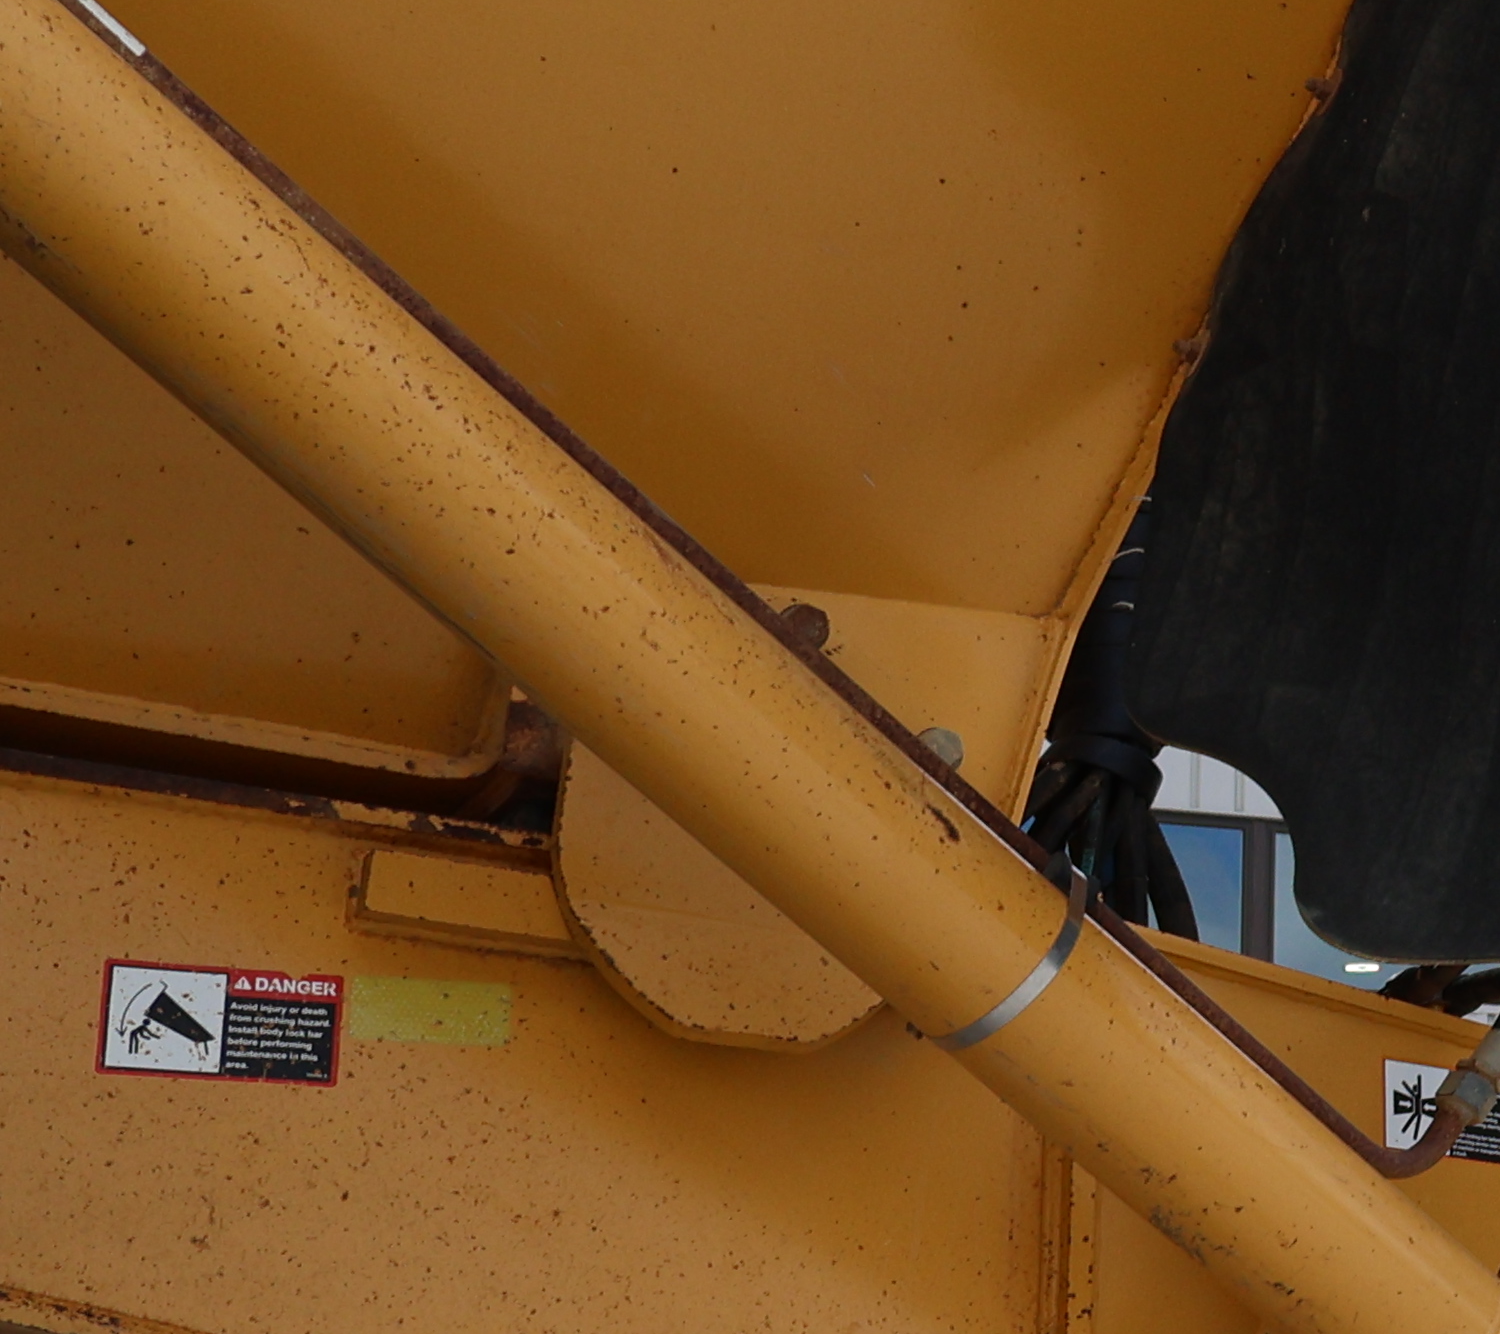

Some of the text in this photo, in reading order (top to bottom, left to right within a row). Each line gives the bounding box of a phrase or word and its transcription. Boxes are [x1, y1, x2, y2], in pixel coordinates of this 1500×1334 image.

[255, 977, 337, 996] DANGER
[230, 1001, 259, 1011] Avoid
[260, 1004, 287, 1016] injury
[301, 1007, 328, 1016] death
[229, 1014, 252, 1022] from
[260, 1027, 284, 1038] body
[227, 1037, 258, 1046] before
